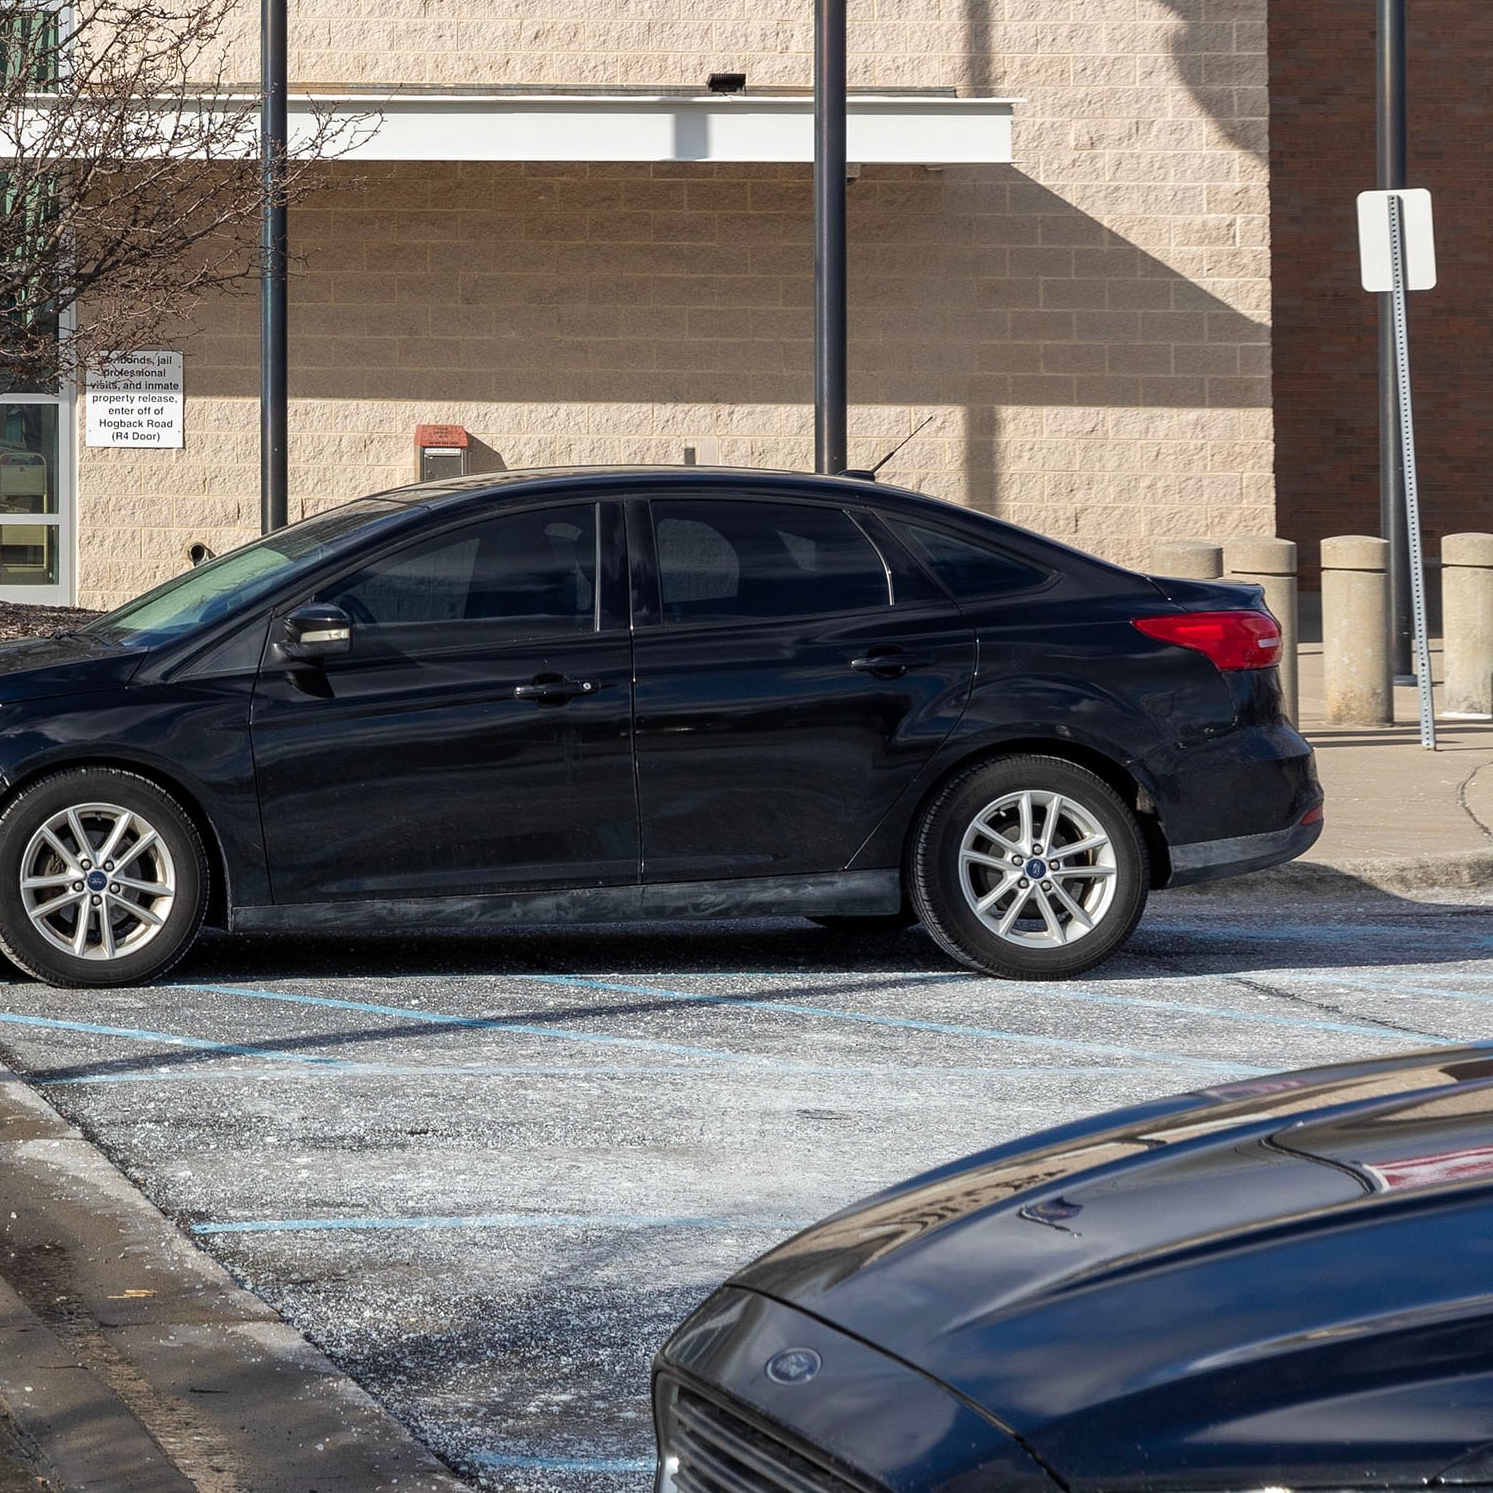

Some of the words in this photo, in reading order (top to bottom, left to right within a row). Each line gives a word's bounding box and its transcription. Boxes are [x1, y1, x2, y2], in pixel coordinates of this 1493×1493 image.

[157, 356, 172, 367] jail
[103, 368, 166, 379] professional
[91, 380, 120, 391] visits,
[123, 381, 142, 390] and
[144, 381, 179, 391] inmate
[92, 394, 135, 405] property
[138, 394, 178, 404] release,
[108, 407, 134, 415] enter
[137, 406, 151, 415] off
[154, 406, 164, 415] of
[99, 418, 144, 429] Hogback
[146, 419, 173, 428] Road
[111, 431, 129, 442] (R4
[132, 431, 161, 442] Door)
